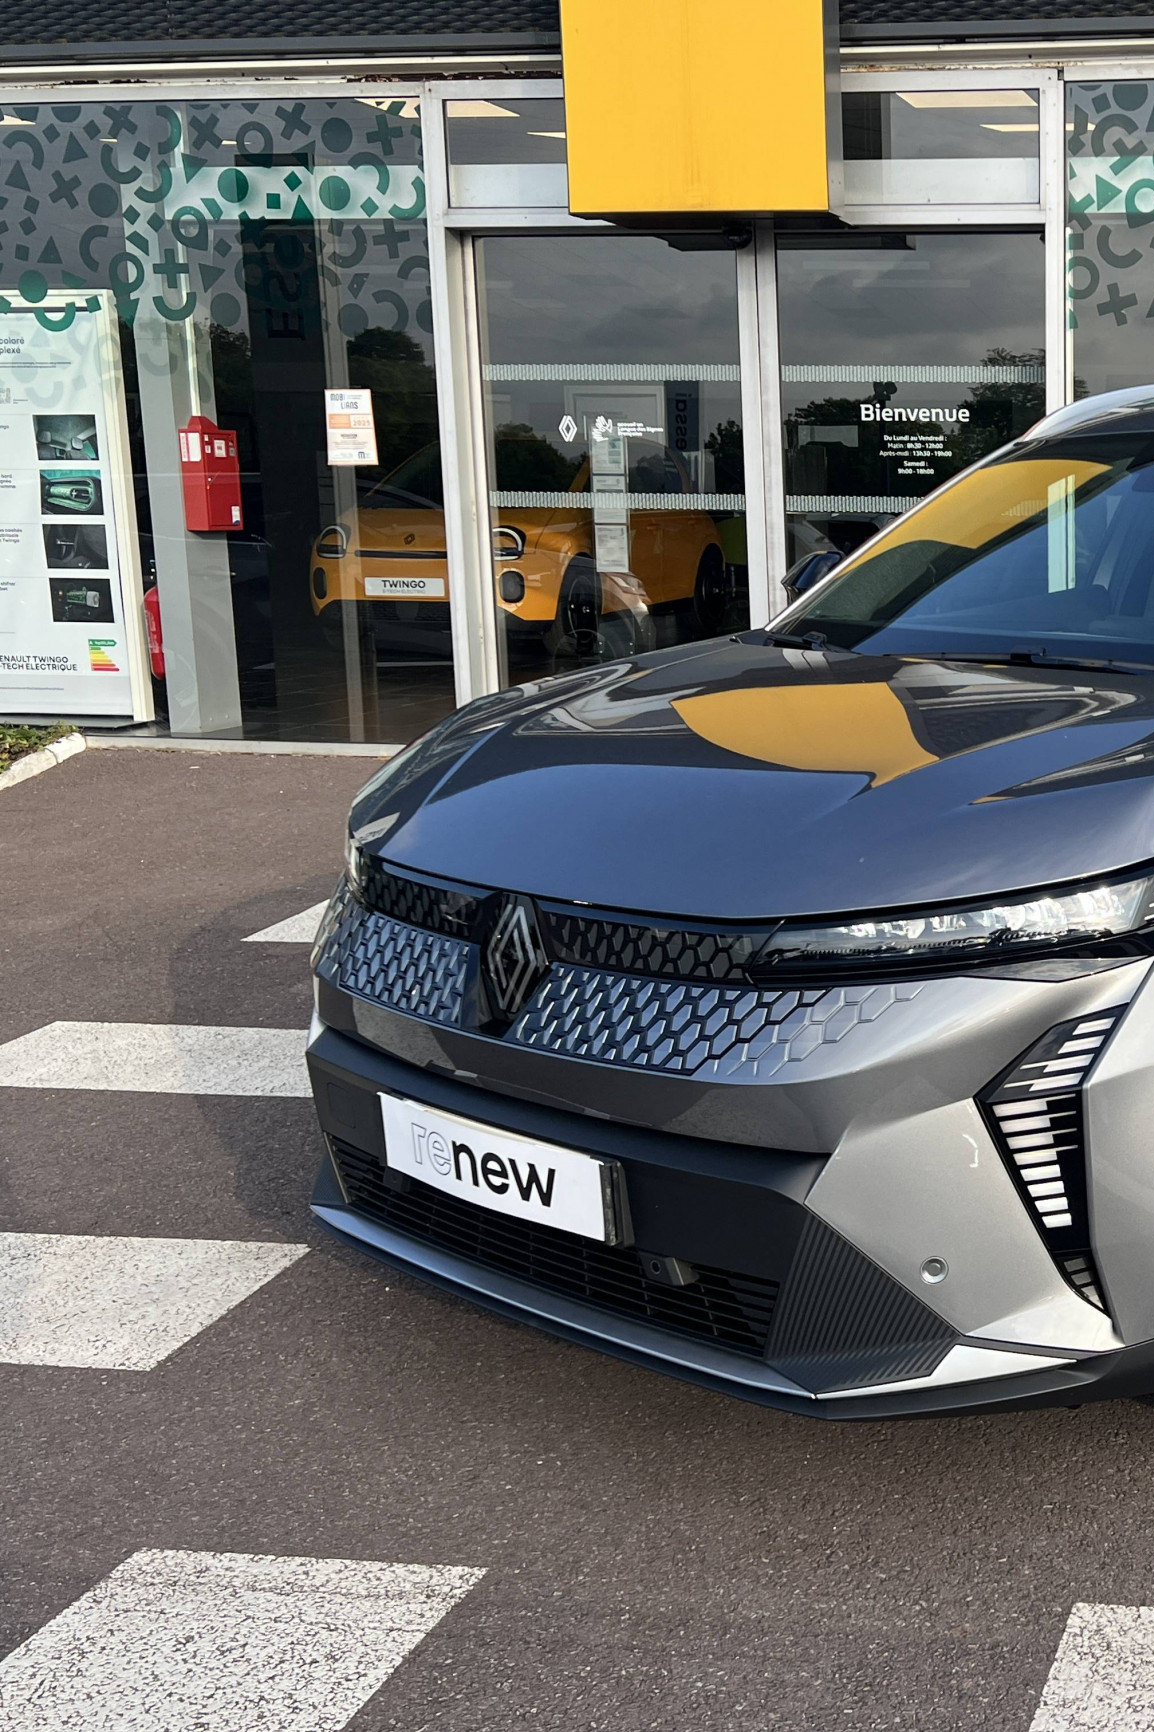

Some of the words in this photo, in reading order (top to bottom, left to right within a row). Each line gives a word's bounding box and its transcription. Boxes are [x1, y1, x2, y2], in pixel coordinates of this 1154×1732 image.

[860, 403, 970, 422] Bienvenue
[381, 579, 426, 589] TWINGO
[32, 655, 69, 664] TWINGO
[26, 662, 78, 672] ELECTRIQUE
[411, 1122, 556, 1208] renew
